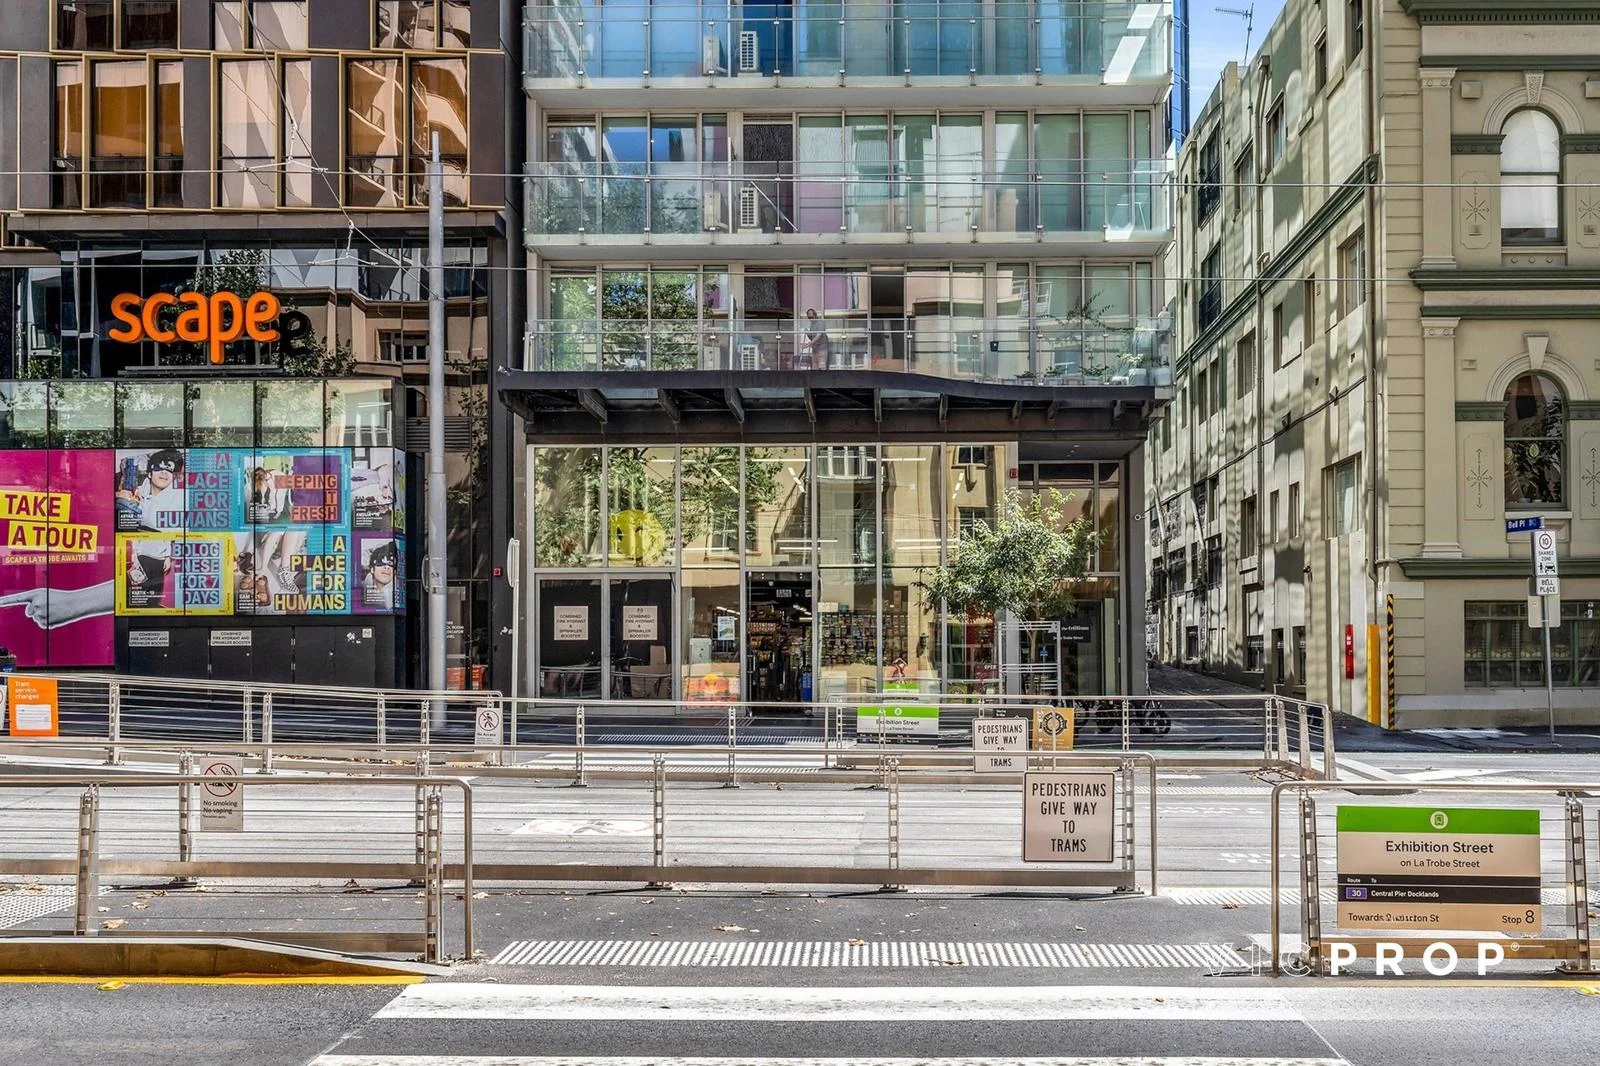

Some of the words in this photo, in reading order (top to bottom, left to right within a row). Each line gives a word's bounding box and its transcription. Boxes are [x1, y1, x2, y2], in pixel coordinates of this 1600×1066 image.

[108, 290, 280, 364] scape
[216, 453, 229, 470] A
[173, 472, 229, 489] PLACE
[5, 494, 61, 517] TAKE
[196, 492, 228, 508] FOR
[157, 511, 229, 528] HUMANS
[292, 508, 336, 520] FRESH
[12, 526, 26, 546] A
[33, 526, 93, 550] TOUR
[334, 536, 346, 552] A
[174, 544, 219, 558] BOLOG
[292, 555, 346, 572] PLACE
[181, 576, 206, 588] FOR
[312, 575, 346, 590] FOR
[184, 590, 219, 604] DAYS
[275, 594, 346, 610] HUMANS
[978, 725, 1023, 734] PEDESTRIANS
[984, 736, 998, 744] GIVE
[1003, 736, 1017, 744] WAY
[990, 759, 1012, 767] TRAMS
[1032, 783, 1106, 797] PEDESTRIANS
[1041, 802, 1065, 815] GIVE
[1074, 802, 1097, 815] WAY
[1062, 820, 1075, 833] TO
[1051, 839, 1086, 852] TRAMS
[1386, 840, 1448, 853] Exhibition
[1453, 842, 1494, 853] Street
[1427, 859, 1450, 867] Trobe
[1348, 912, 1384, 922] Towards
[1430, 914, 1439, 922] St
[1502, 915, 1522, 925] Stop
[1525, 910, 1535, 924] 8
